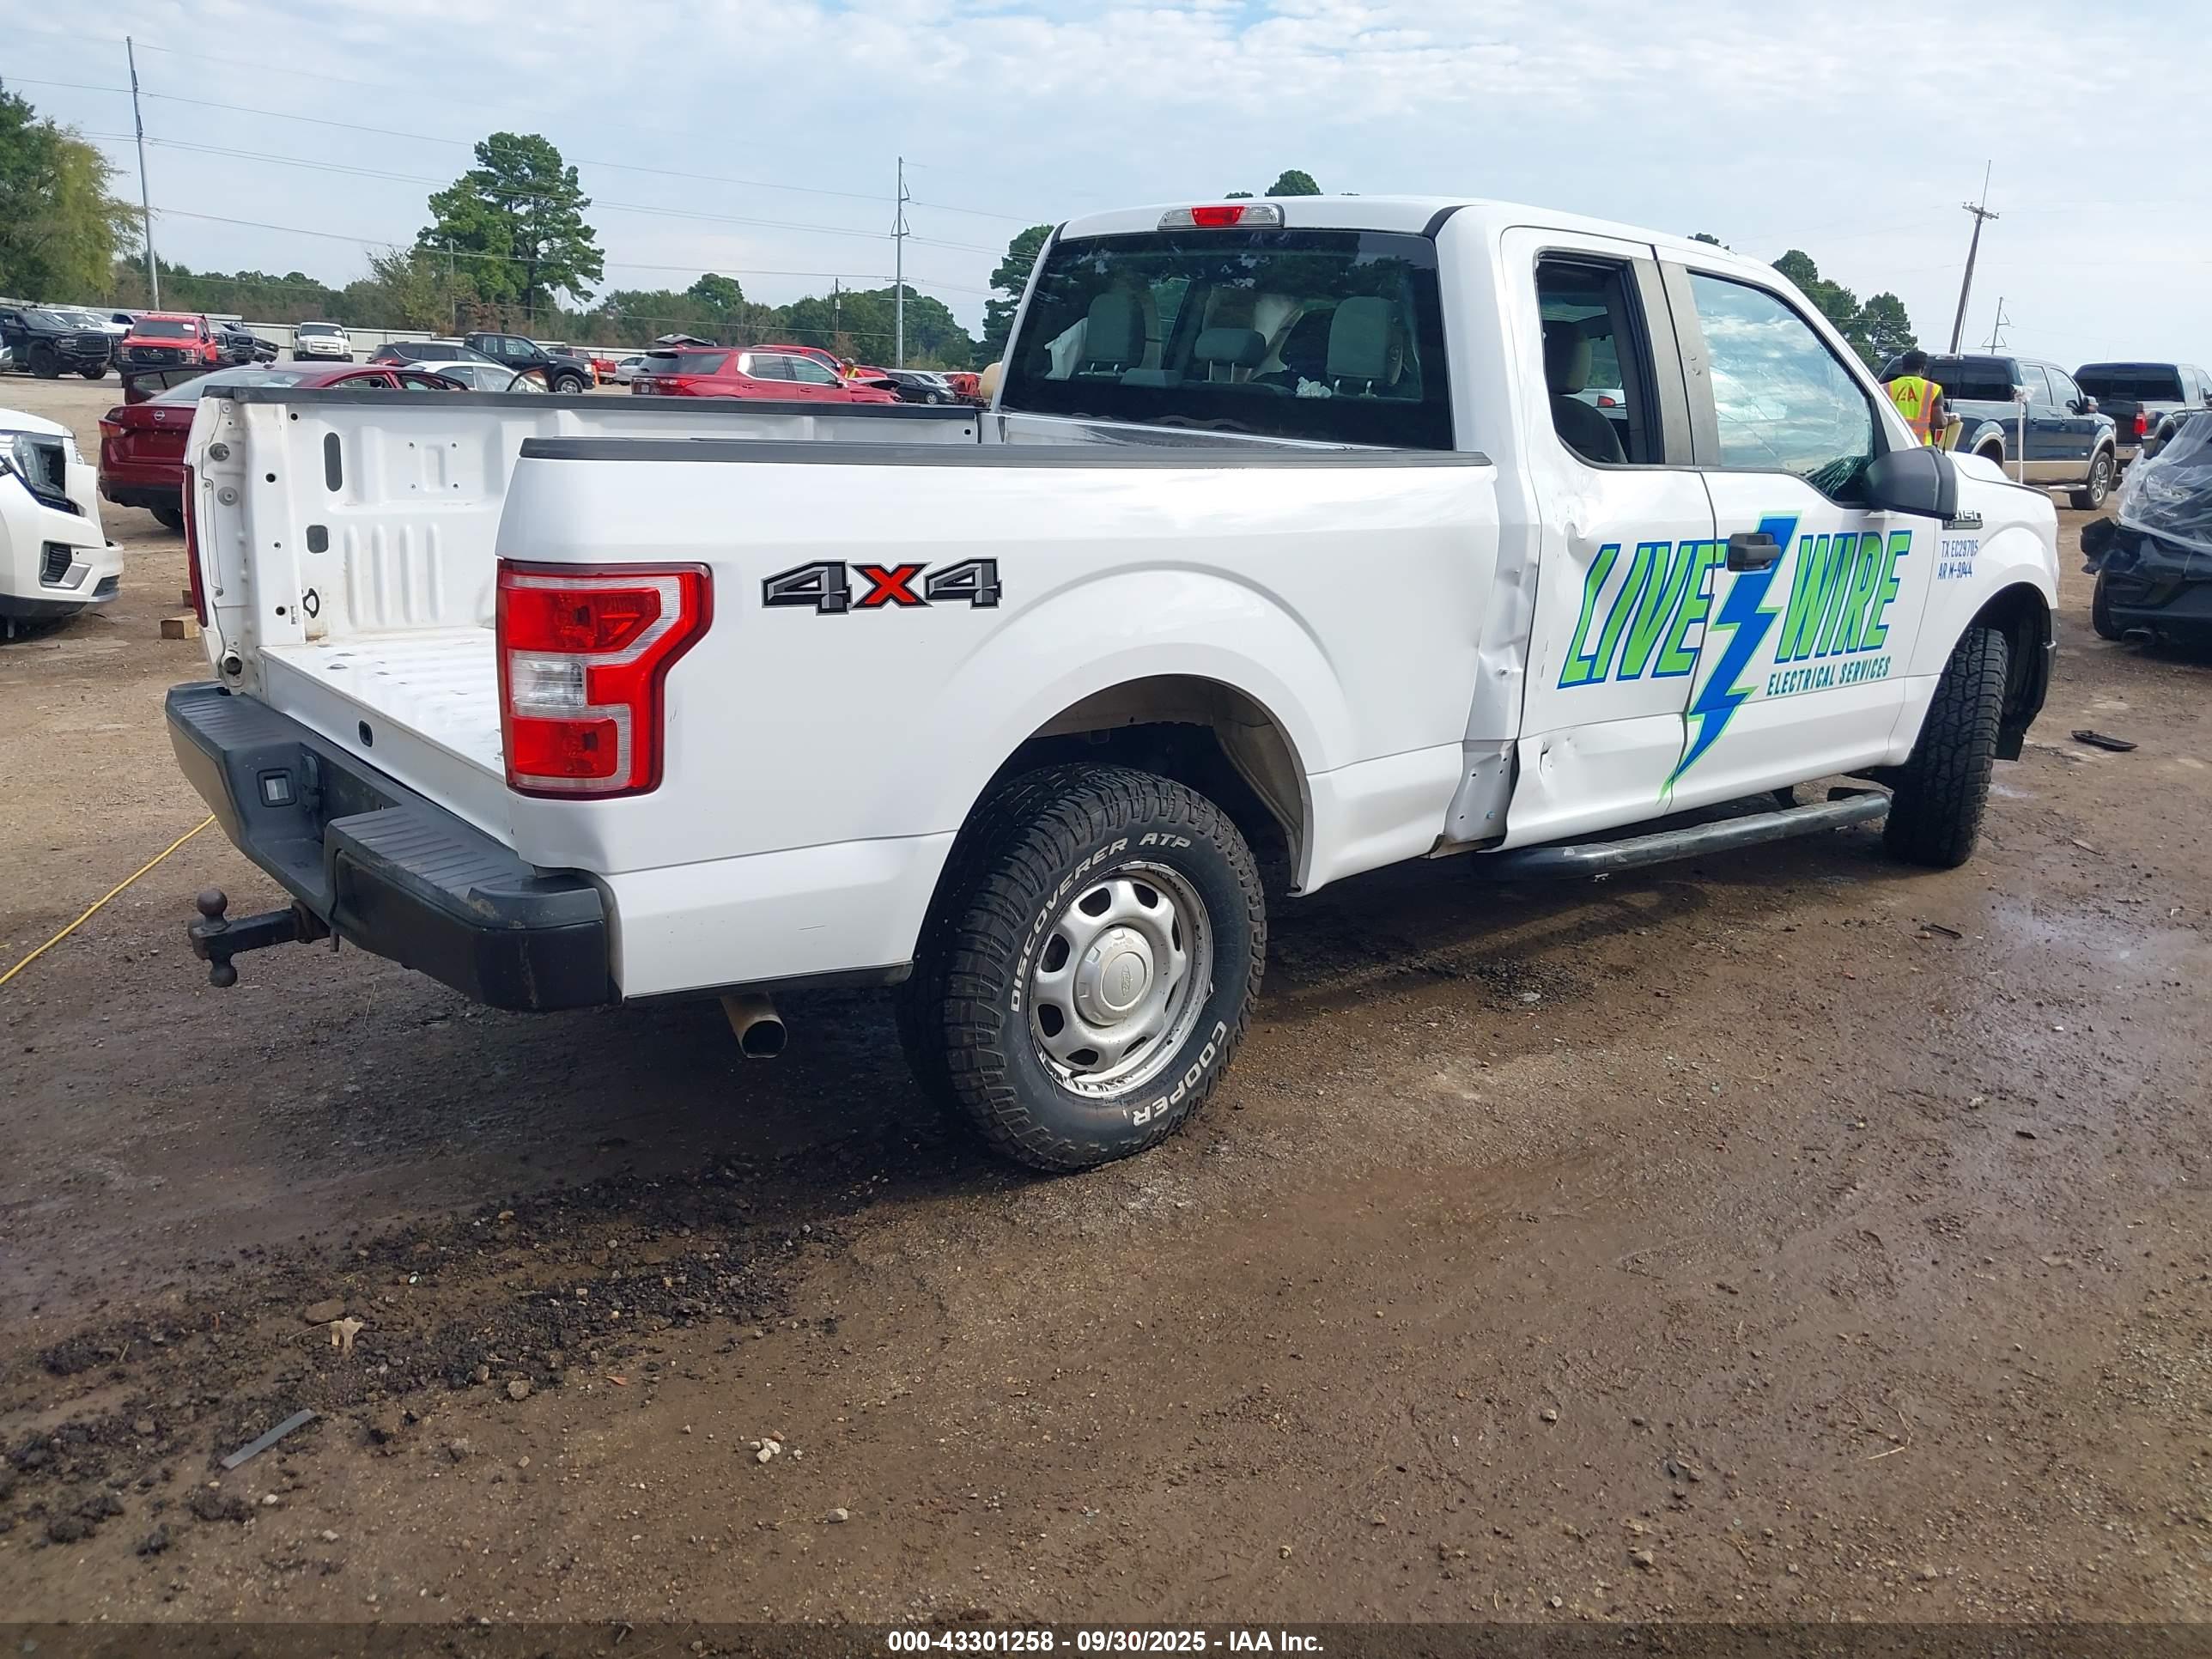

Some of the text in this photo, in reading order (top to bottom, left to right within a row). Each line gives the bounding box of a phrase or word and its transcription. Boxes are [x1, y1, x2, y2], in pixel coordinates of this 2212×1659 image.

[1937, 562, 1948, 580] AR
[1941, 540, 1950, 558] TX
[1558, 529, 1913, 690] LIVE WIRE
[1765, 655, 1892, 696] ELECTRICAL SERVICES
[1010, 832, 1192, 1012] DISCOVERER ATP
[1133, 1020, 1227, 1127] COOPER
